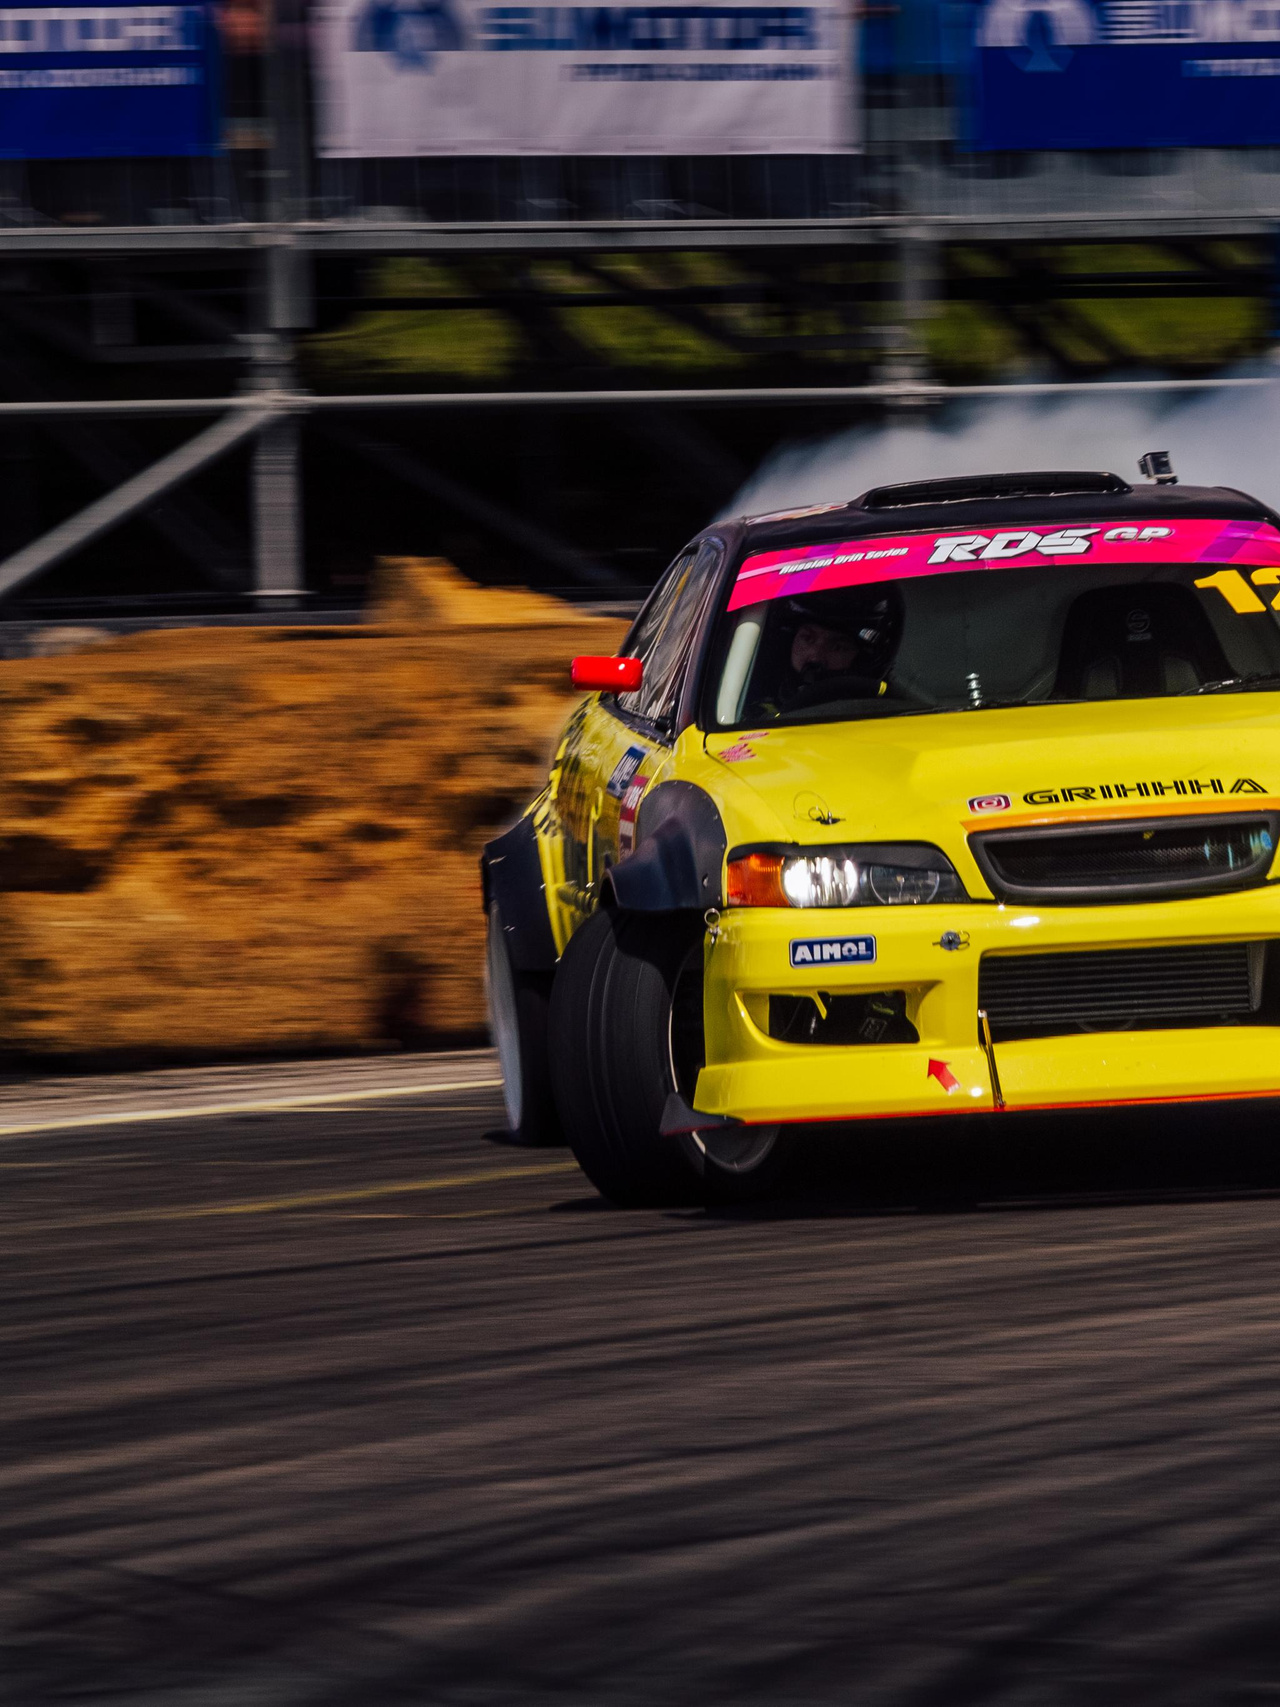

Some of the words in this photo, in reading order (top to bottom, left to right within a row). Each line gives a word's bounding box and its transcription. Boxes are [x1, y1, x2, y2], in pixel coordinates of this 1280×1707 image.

[779, 558, 834, 575] Russian
[833, 552, 865, 565] Drift
[864, 547, 909, 560] Series
[926, 528, 1102, 564] RDS
[1102, 526, 1175, 543] GP
[794, 941, 872, 962] AIMOL
